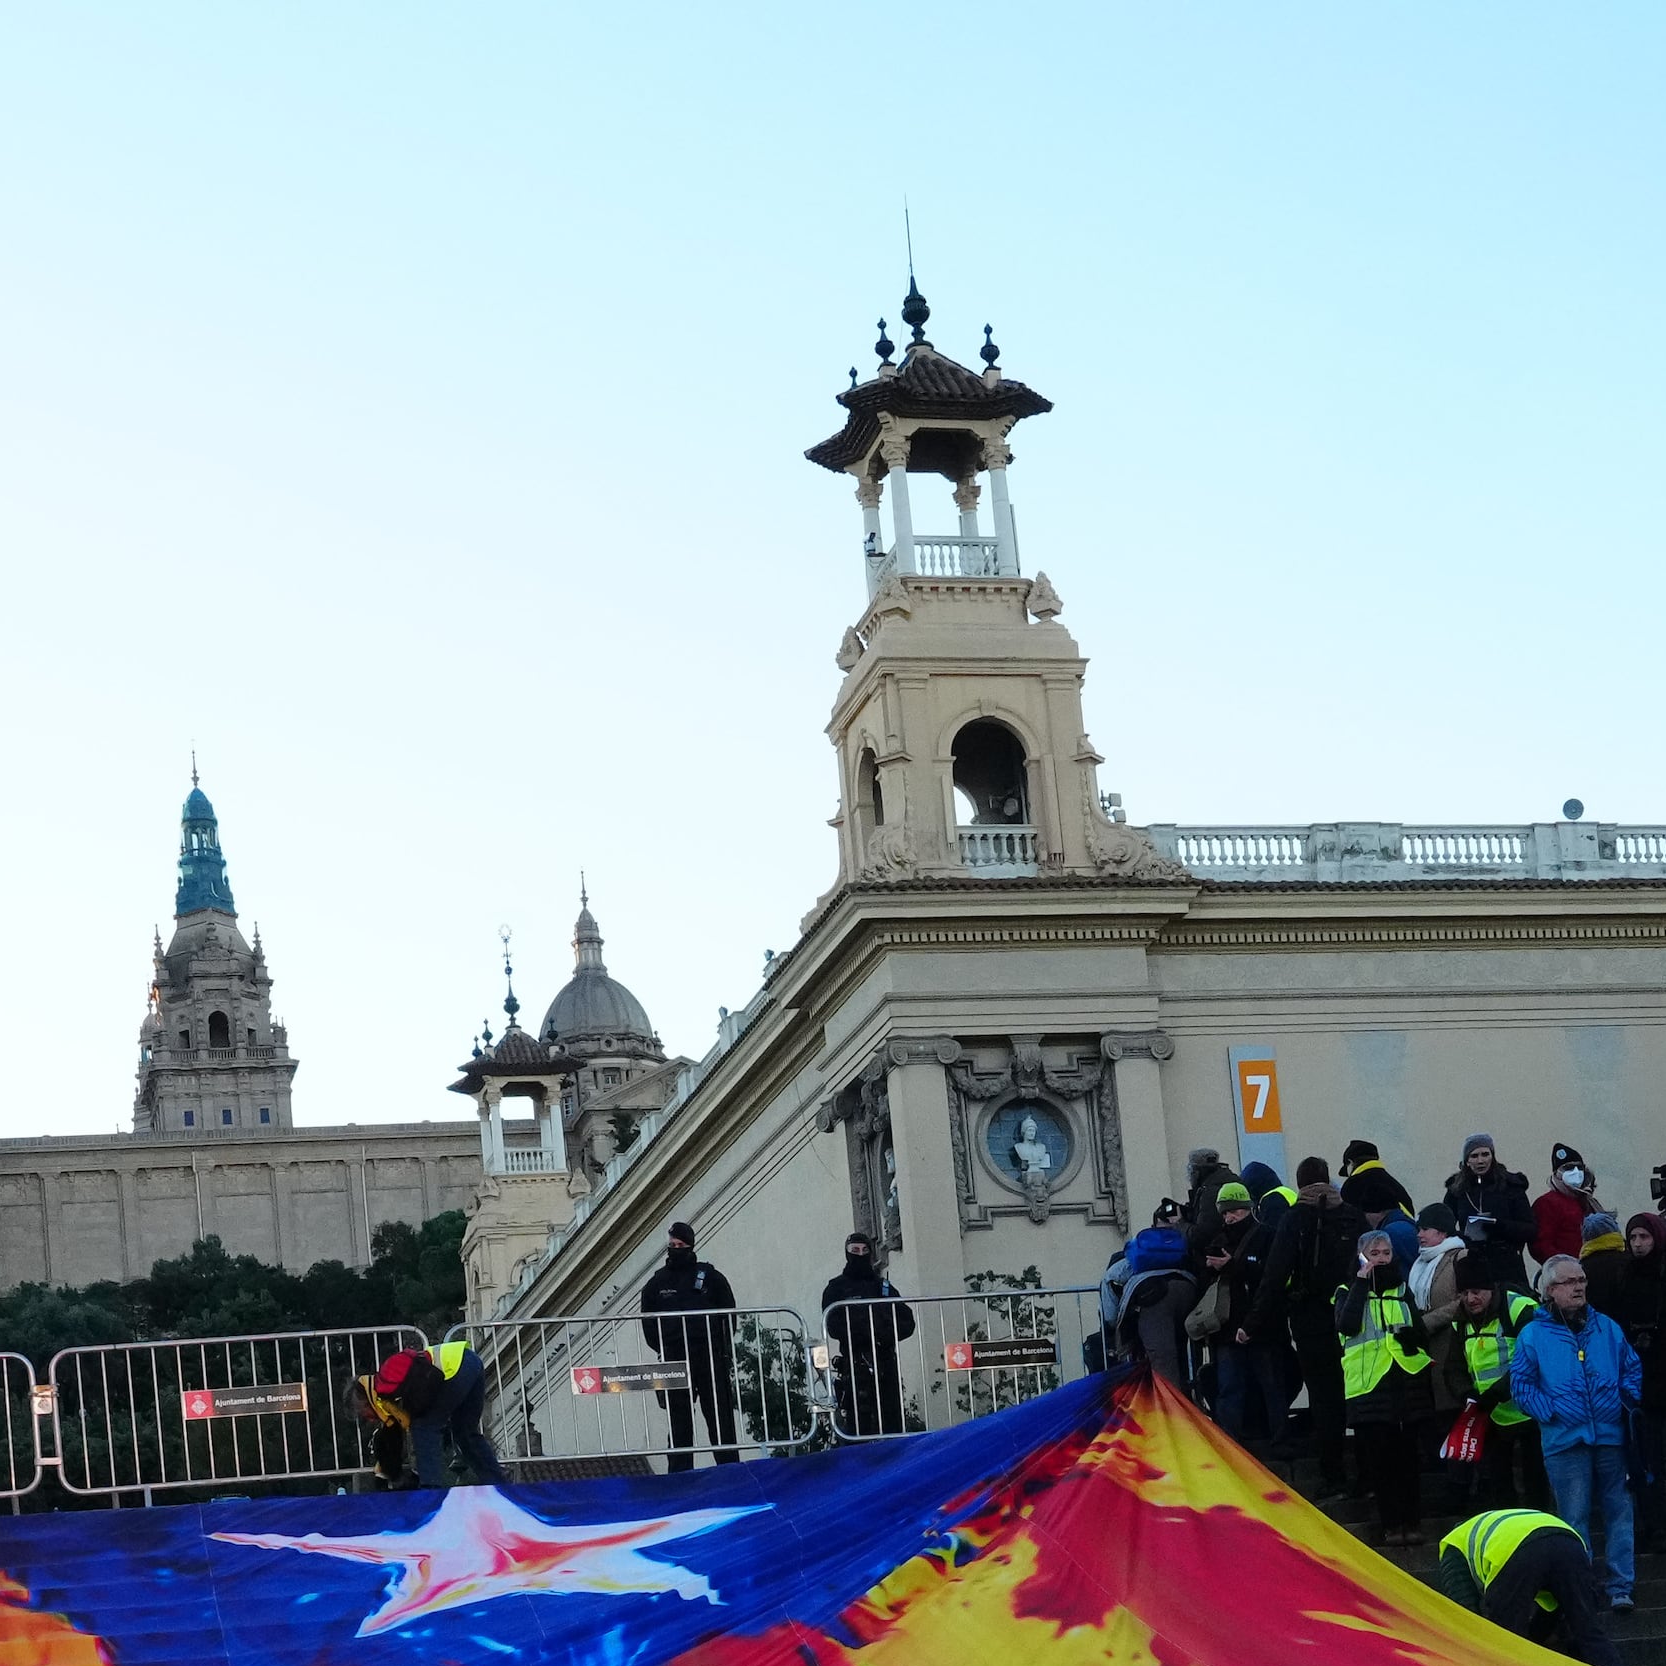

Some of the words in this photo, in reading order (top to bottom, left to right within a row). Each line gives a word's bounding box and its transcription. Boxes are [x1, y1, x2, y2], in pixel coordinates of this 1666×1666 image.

[1245, 1074, 1271, 1119] 7
[973, 1348, 1011, 1358] Ajuntament
[1012, 1348, 1021, 1356] de
[1022, 1347, 1054, 1355] Barcelona
[602, 1374, 641, 1384] Ajuntament
[652, 1371, 686, 1379] Barcelona
[214, 1397, 255, 1408] Ajuntament
[267, 1393, 301, 1402] Barcelona
